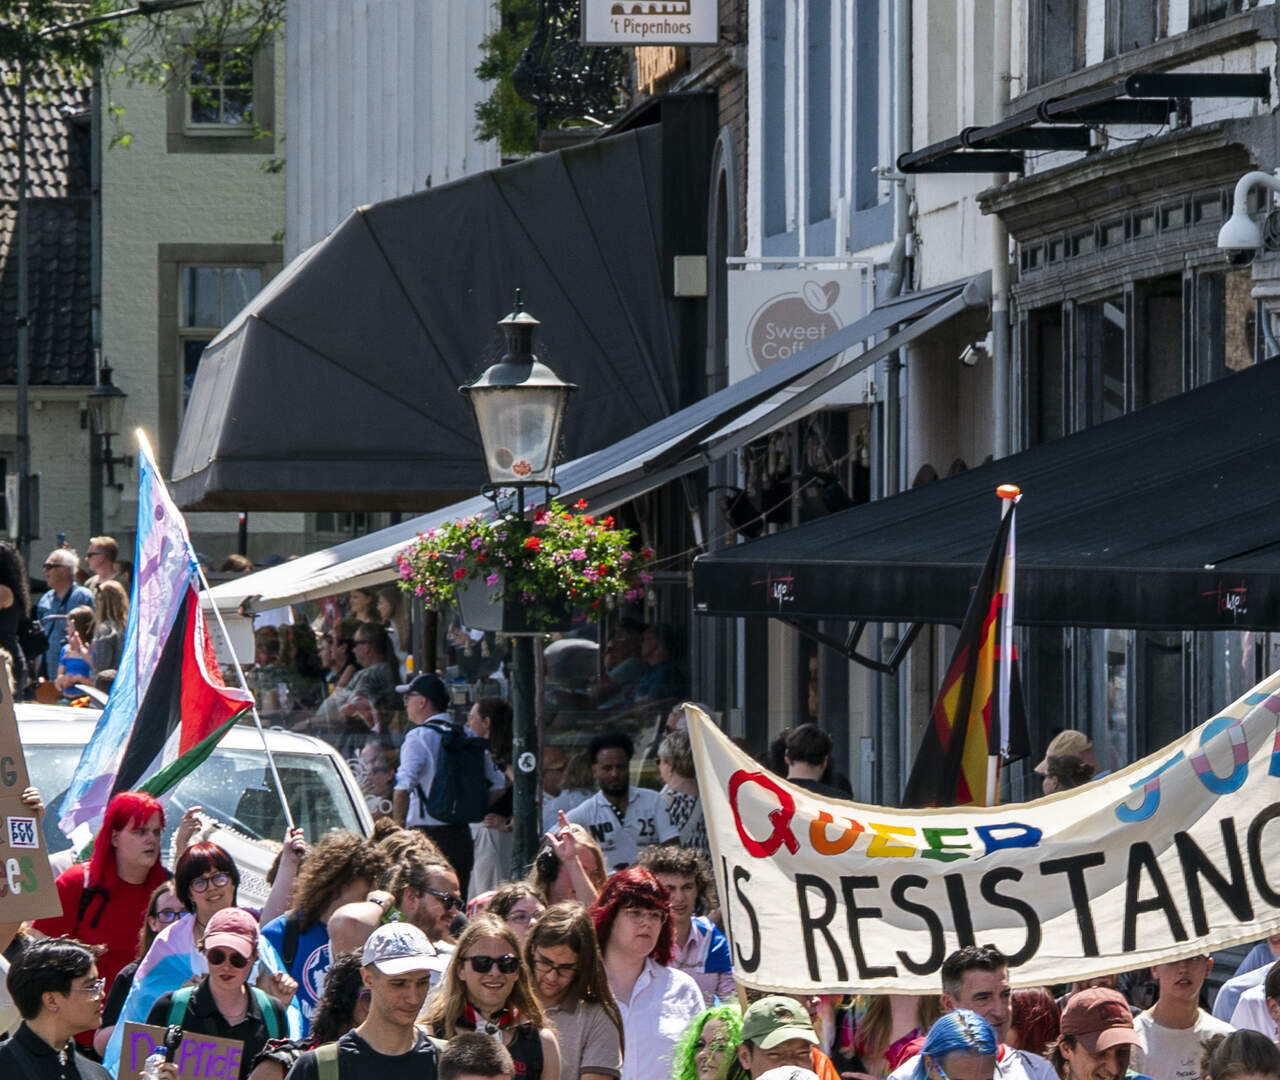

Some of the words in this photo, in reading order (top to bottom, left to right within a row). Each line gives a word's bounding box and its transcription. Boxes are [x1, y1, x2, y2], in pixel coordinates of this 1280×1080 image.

[623, 18, 692, 37] Piepenhoes
[765, 322, 826, 340] Sweet
[761, 341, 804, 359] Coff
[728, 770, 1043, 862] QUEER
[11, 822, 33, 833] FCK
[637, 818, 656, 836] 25
[12, 832, 34, 843] PVV
[720, 854, 761, 973] IS
